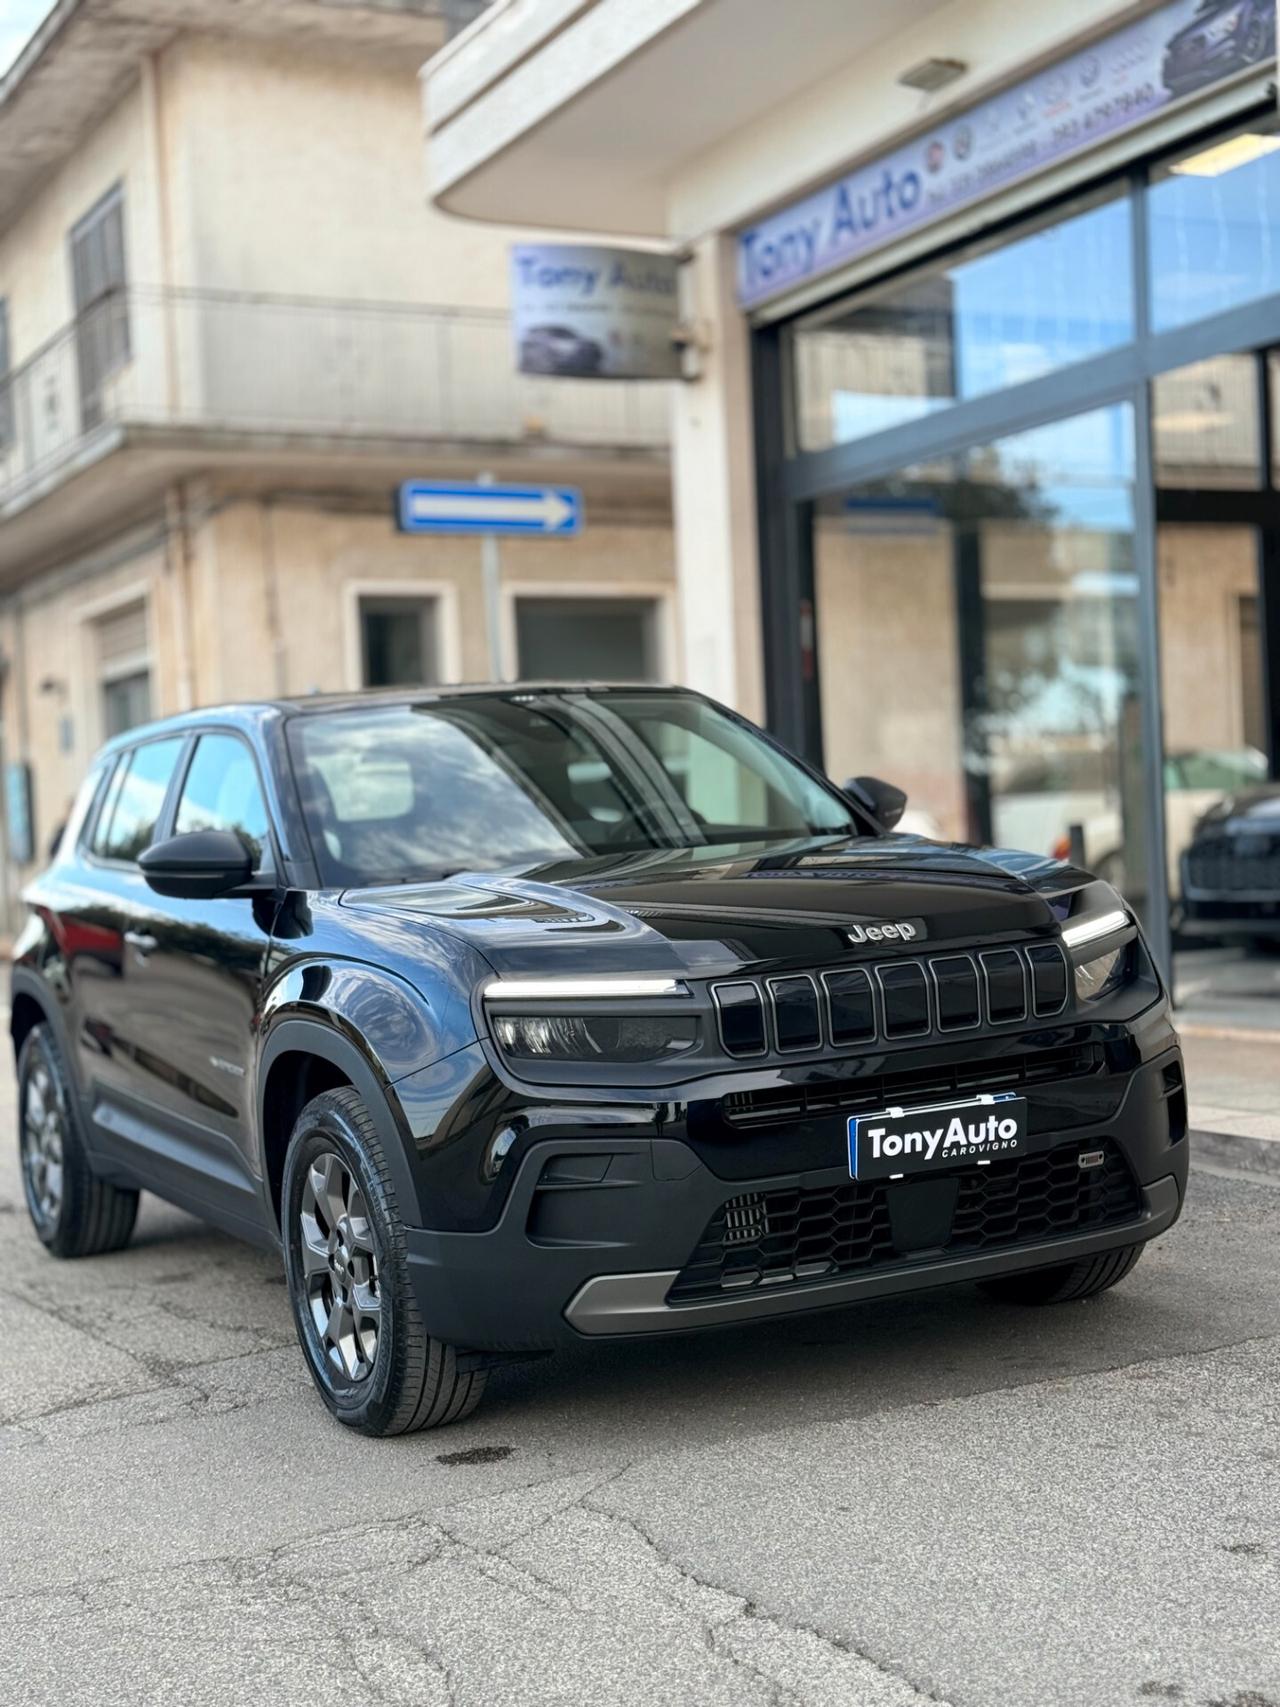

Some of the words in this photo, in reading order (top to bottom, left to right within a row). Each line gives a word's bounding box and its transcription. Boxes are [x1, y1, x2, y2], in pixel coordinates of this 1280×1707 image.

[740, 216, 823, 285] Tony
[830, 168, 921, 247] Auto
[847, 922, 917, 943] Jeep
[867, 1115, 1018, 1161] TonyAuto
[942, 1139, 1018, 1158] CAROVIGNO
